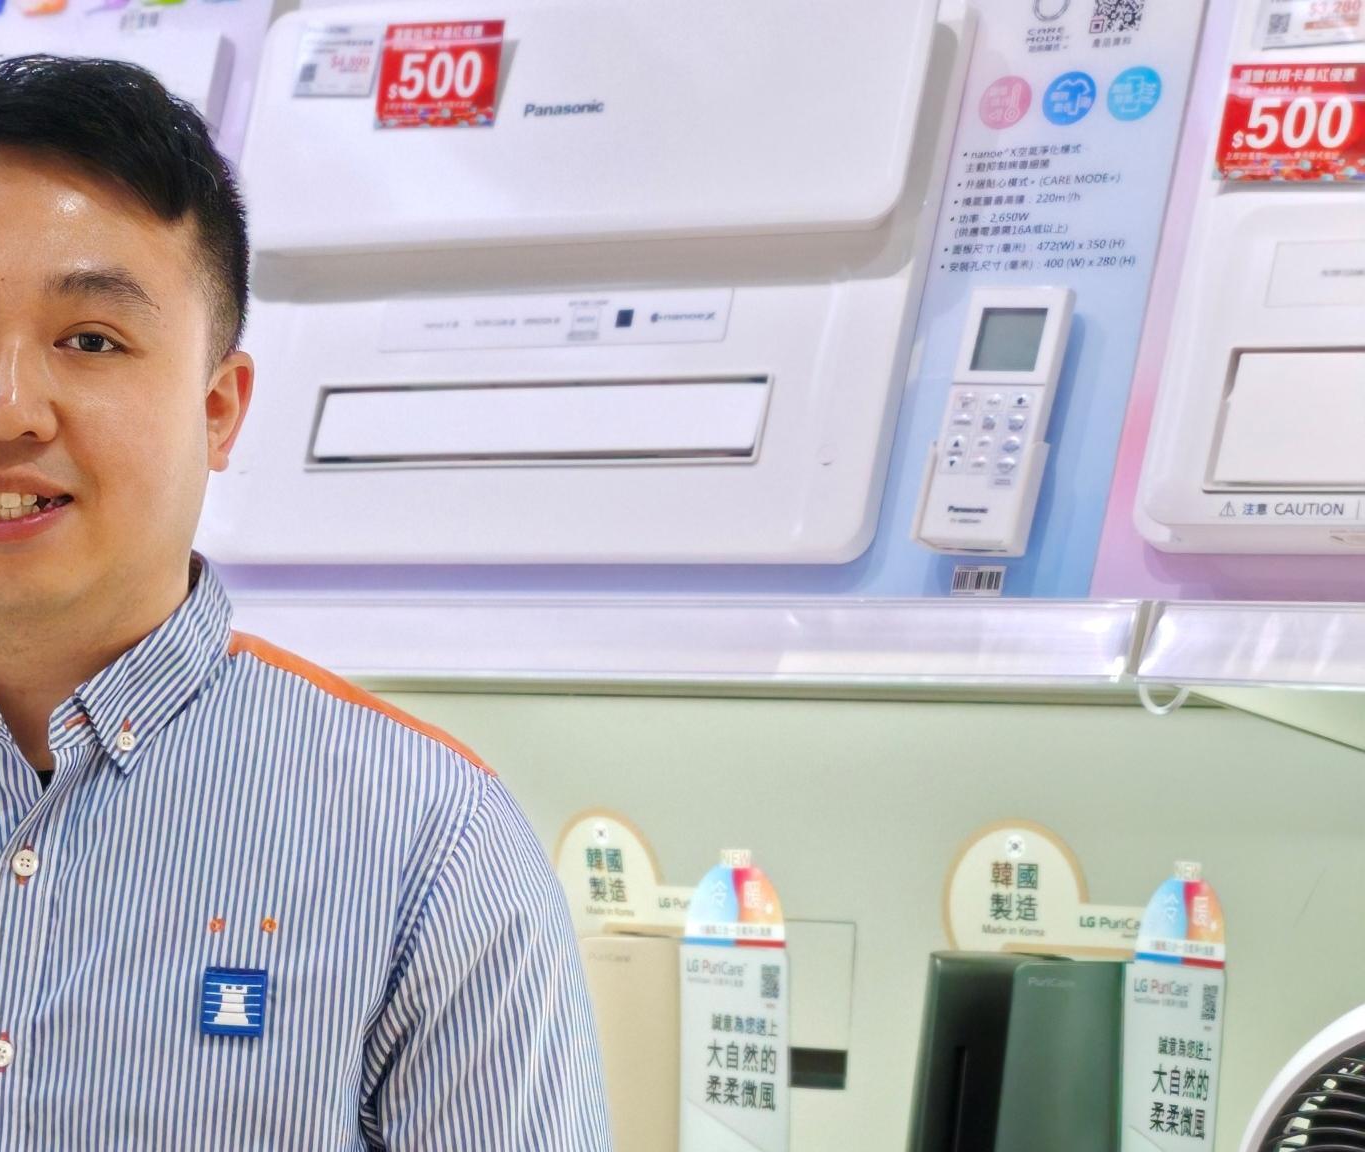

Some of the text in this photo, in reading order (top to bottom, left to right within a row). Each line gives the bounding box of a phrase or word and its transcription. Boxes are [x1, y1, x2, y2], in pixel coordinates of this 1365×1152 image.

[388, 51, 483, 99] $500
[523, 99, 605, 118] Panasonic
[1232, 96, 1354, 149] $500
[1086, 240, 1106, 250] 350
[1108, 239, 1126, 250] (H)
[1044, 259, 1063, 269] 400
[1067, 258, 1085, 269] (W)
[1096, 256, 1116, 267] 280
[1119, 255, 1136, 266] (H)
[947, 505, 989, 514] Panasonic
[1242, 502, 1345, 516] 注意 CAUTION
[991, 860, 1039, 890] 韓國
[589, 877, 628, 903] 製造
[586, 905, 607, 916] Made
[658, 898, 670, 909] LG
[990, 893, 1038, 922] 製造
[982, 924, 1007, 935] Made
[1009, 926, 1017, 935] in
[1079, 916, 1096, 928] LG
[686, 958, 699, 972] LG
[1134, 978, 1148, 993] LG
[711, 1012, 778, 1038] 誠意為您送上
[706, 1041, 778, 1075] 大自然的
[1152, 1067, 1210, 1102] 大自然的
[705, 1077, 776, 1112] 柔柔微風
